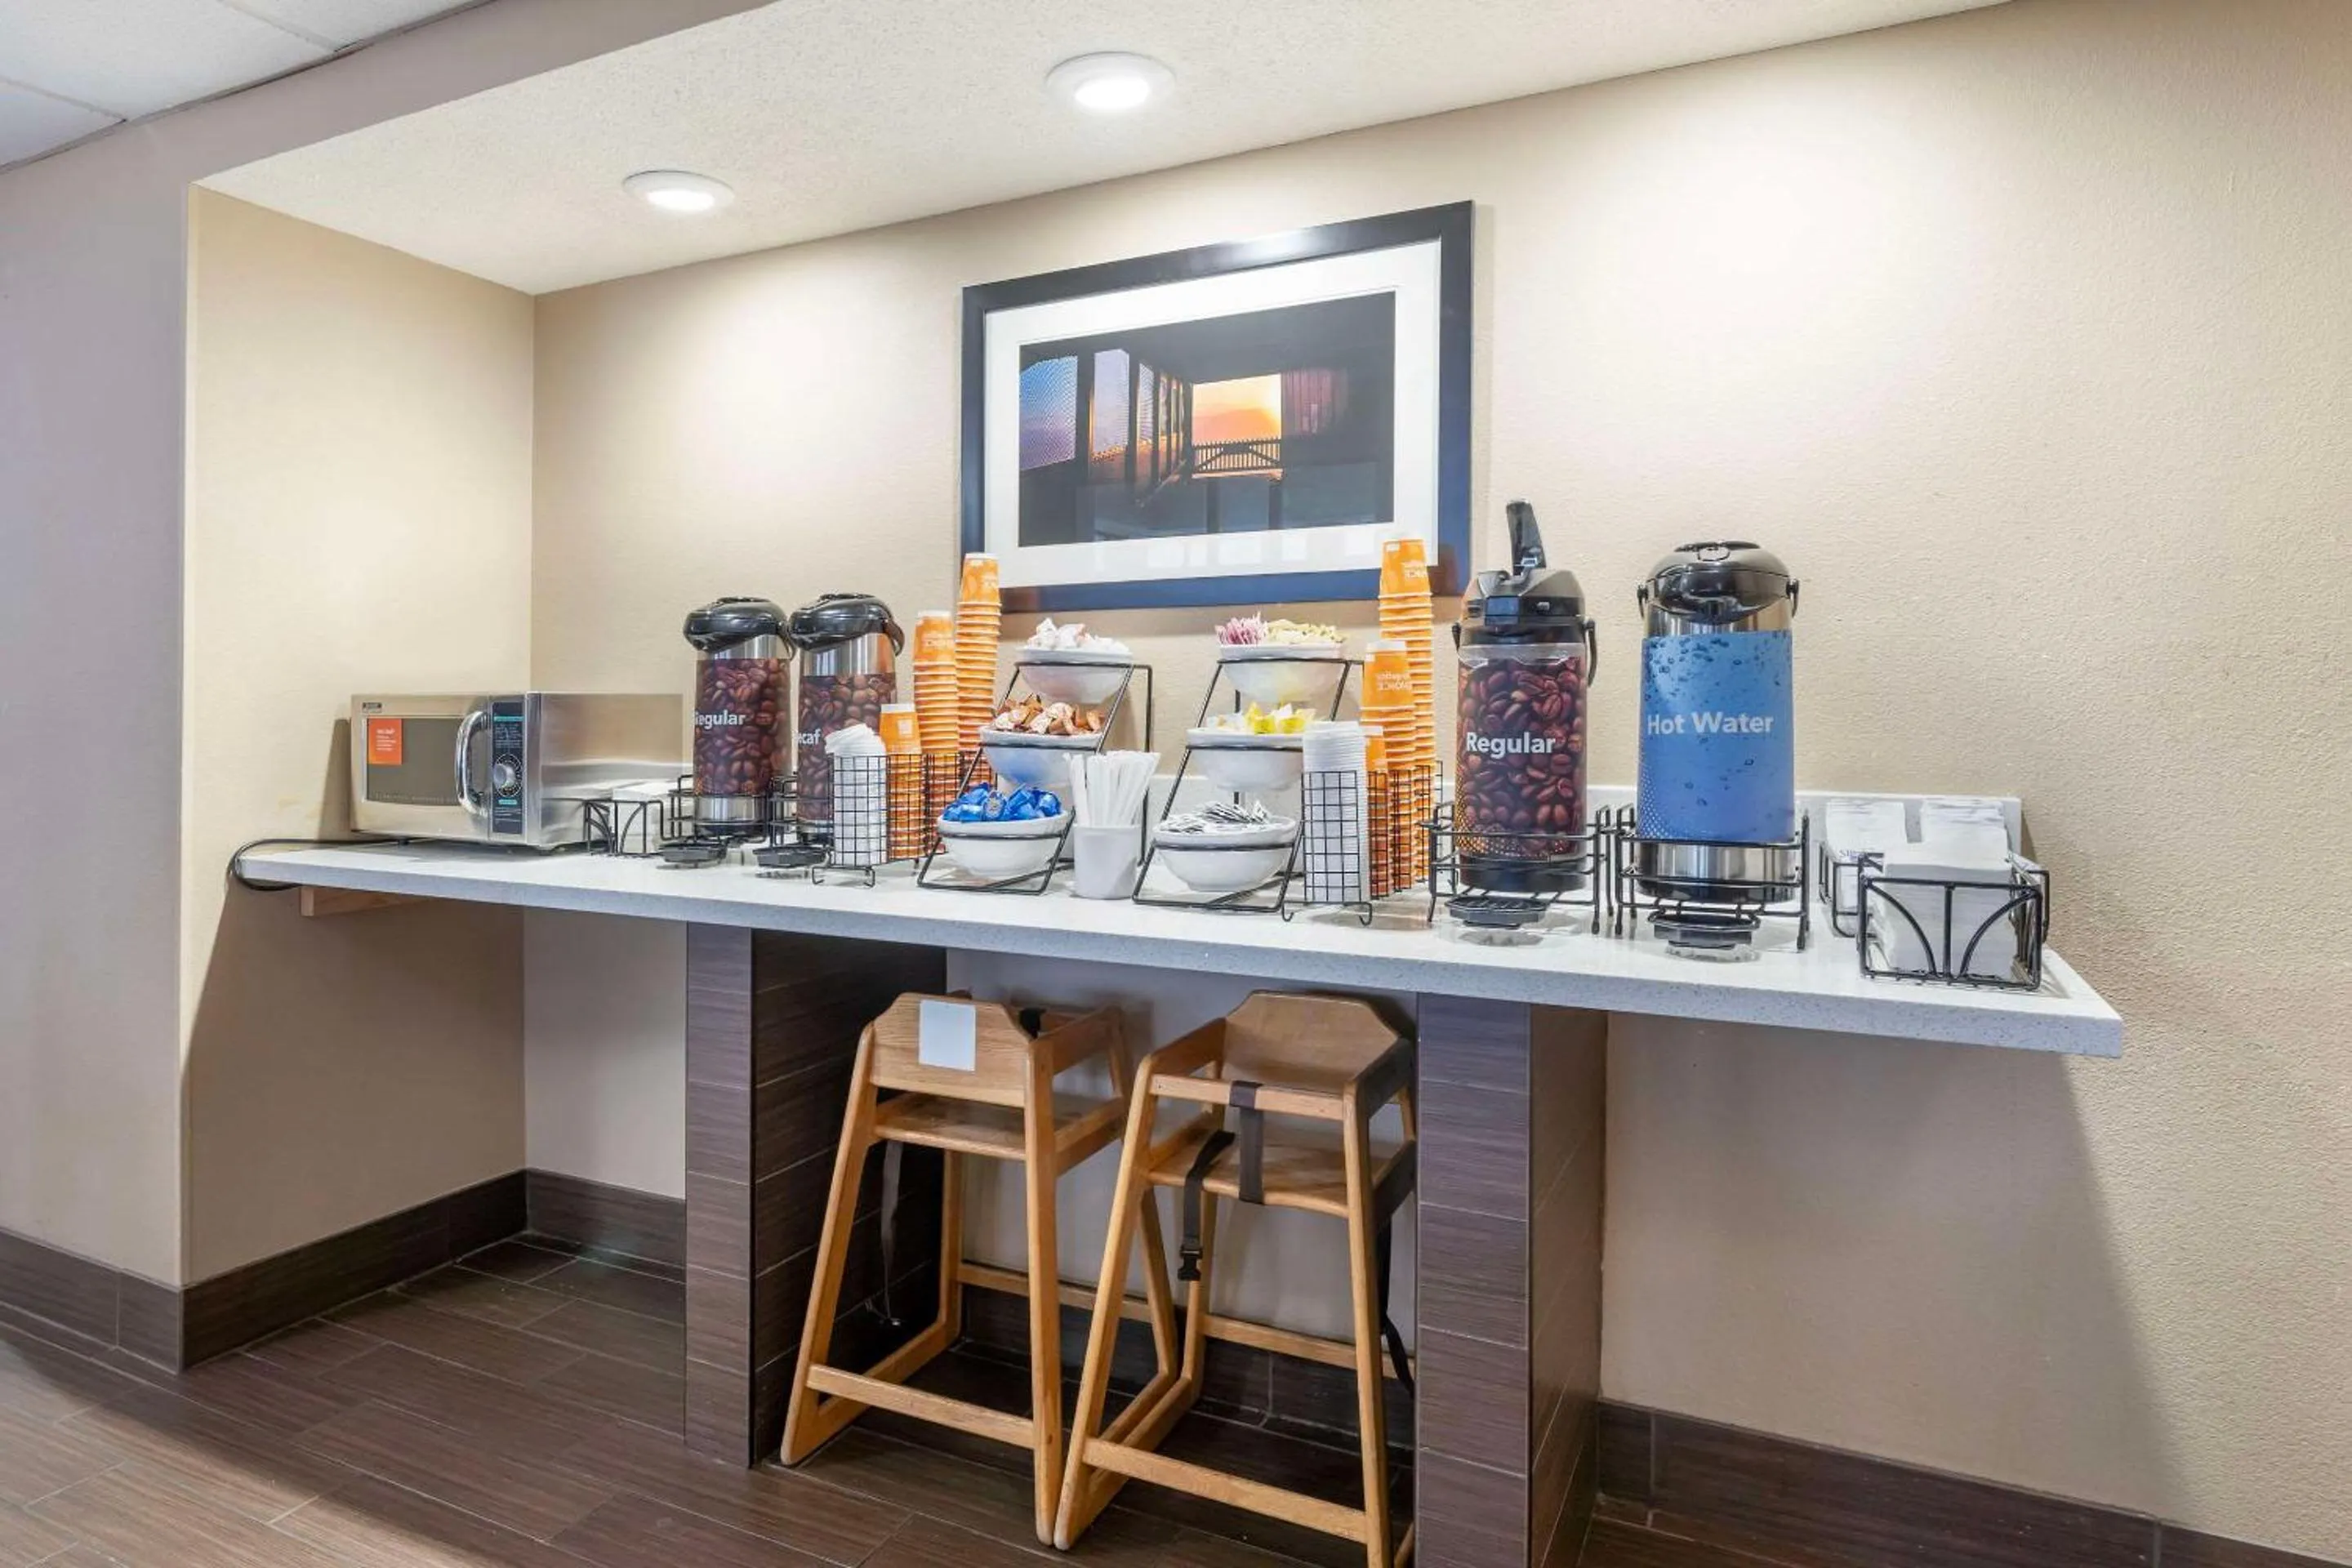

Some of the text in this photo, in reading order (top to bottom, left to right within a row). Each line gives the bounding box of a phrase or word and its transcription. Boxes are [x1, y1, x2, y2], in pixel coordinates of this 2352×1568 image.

[1647, 711, 1775, 735] Hot Water
[796, 728, 822, 744] caf
[1466, 731, 1557, 760] Regular
